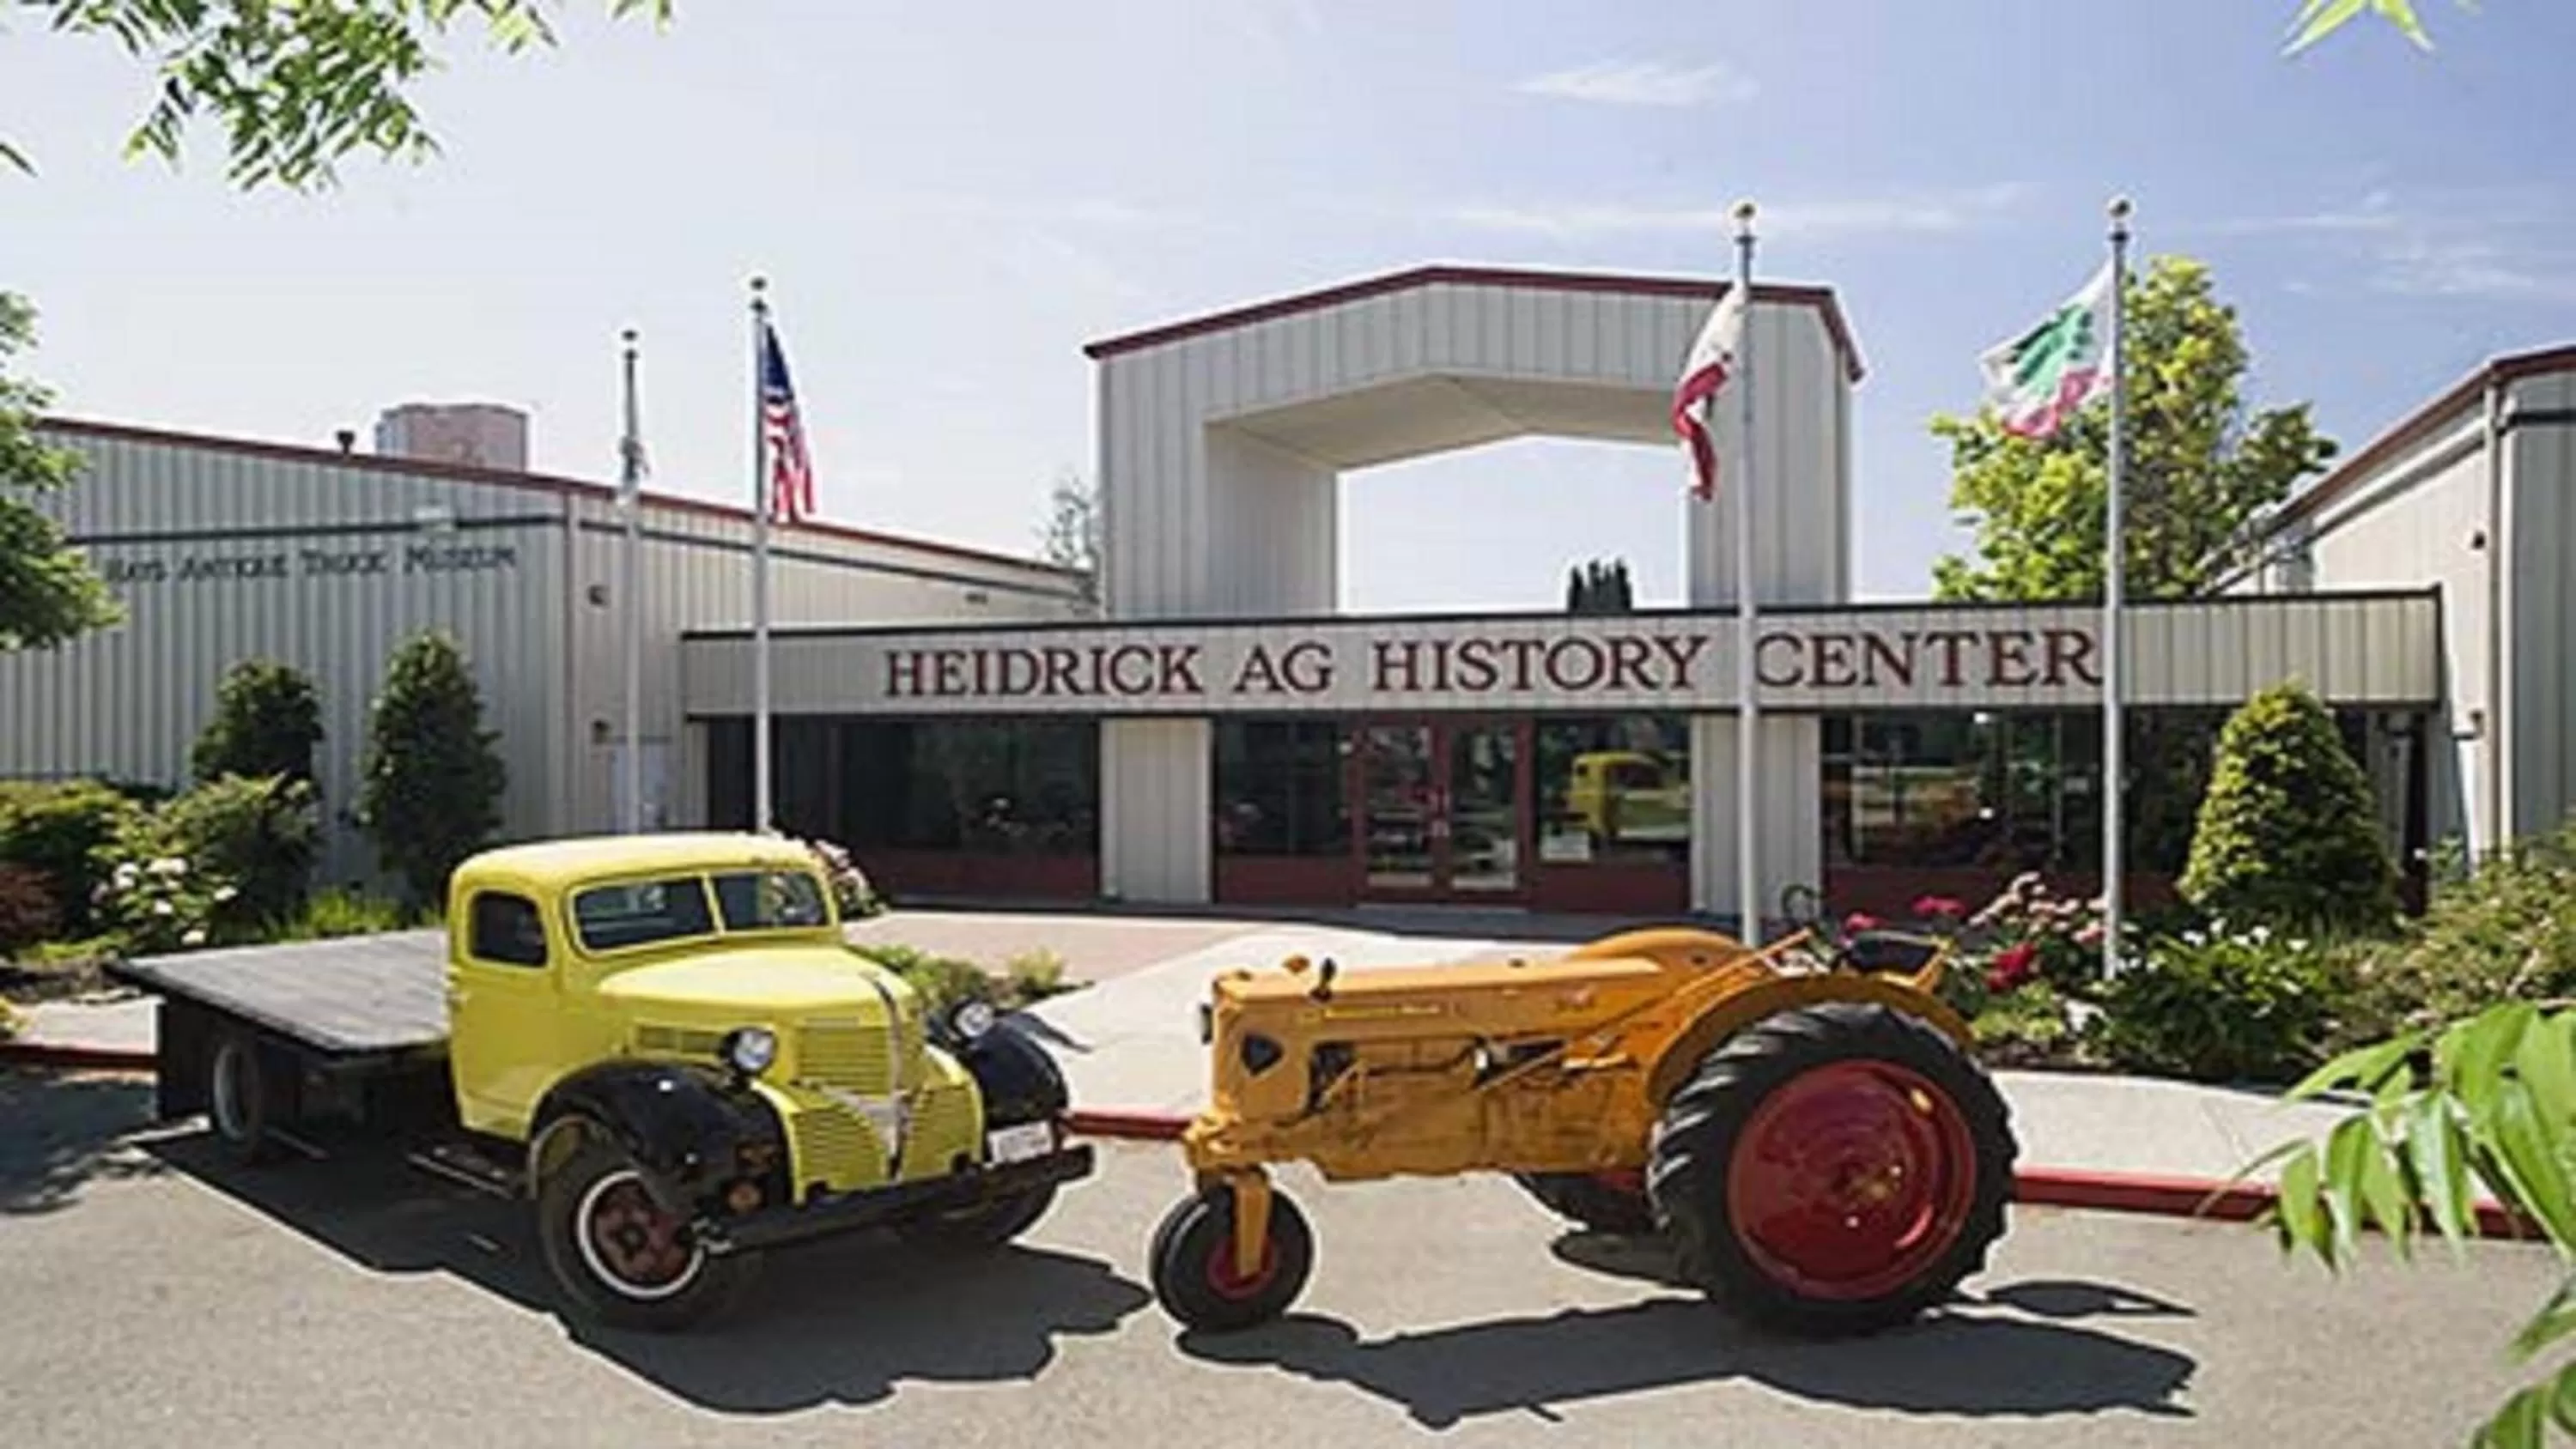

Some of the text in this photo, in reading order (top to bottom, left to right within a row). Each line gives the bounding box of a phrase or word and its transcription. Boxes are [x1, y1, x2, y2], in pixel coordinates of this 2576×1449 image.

[885, 630, 2103, 697] HEIDRICK AG HISTORY CENTER
